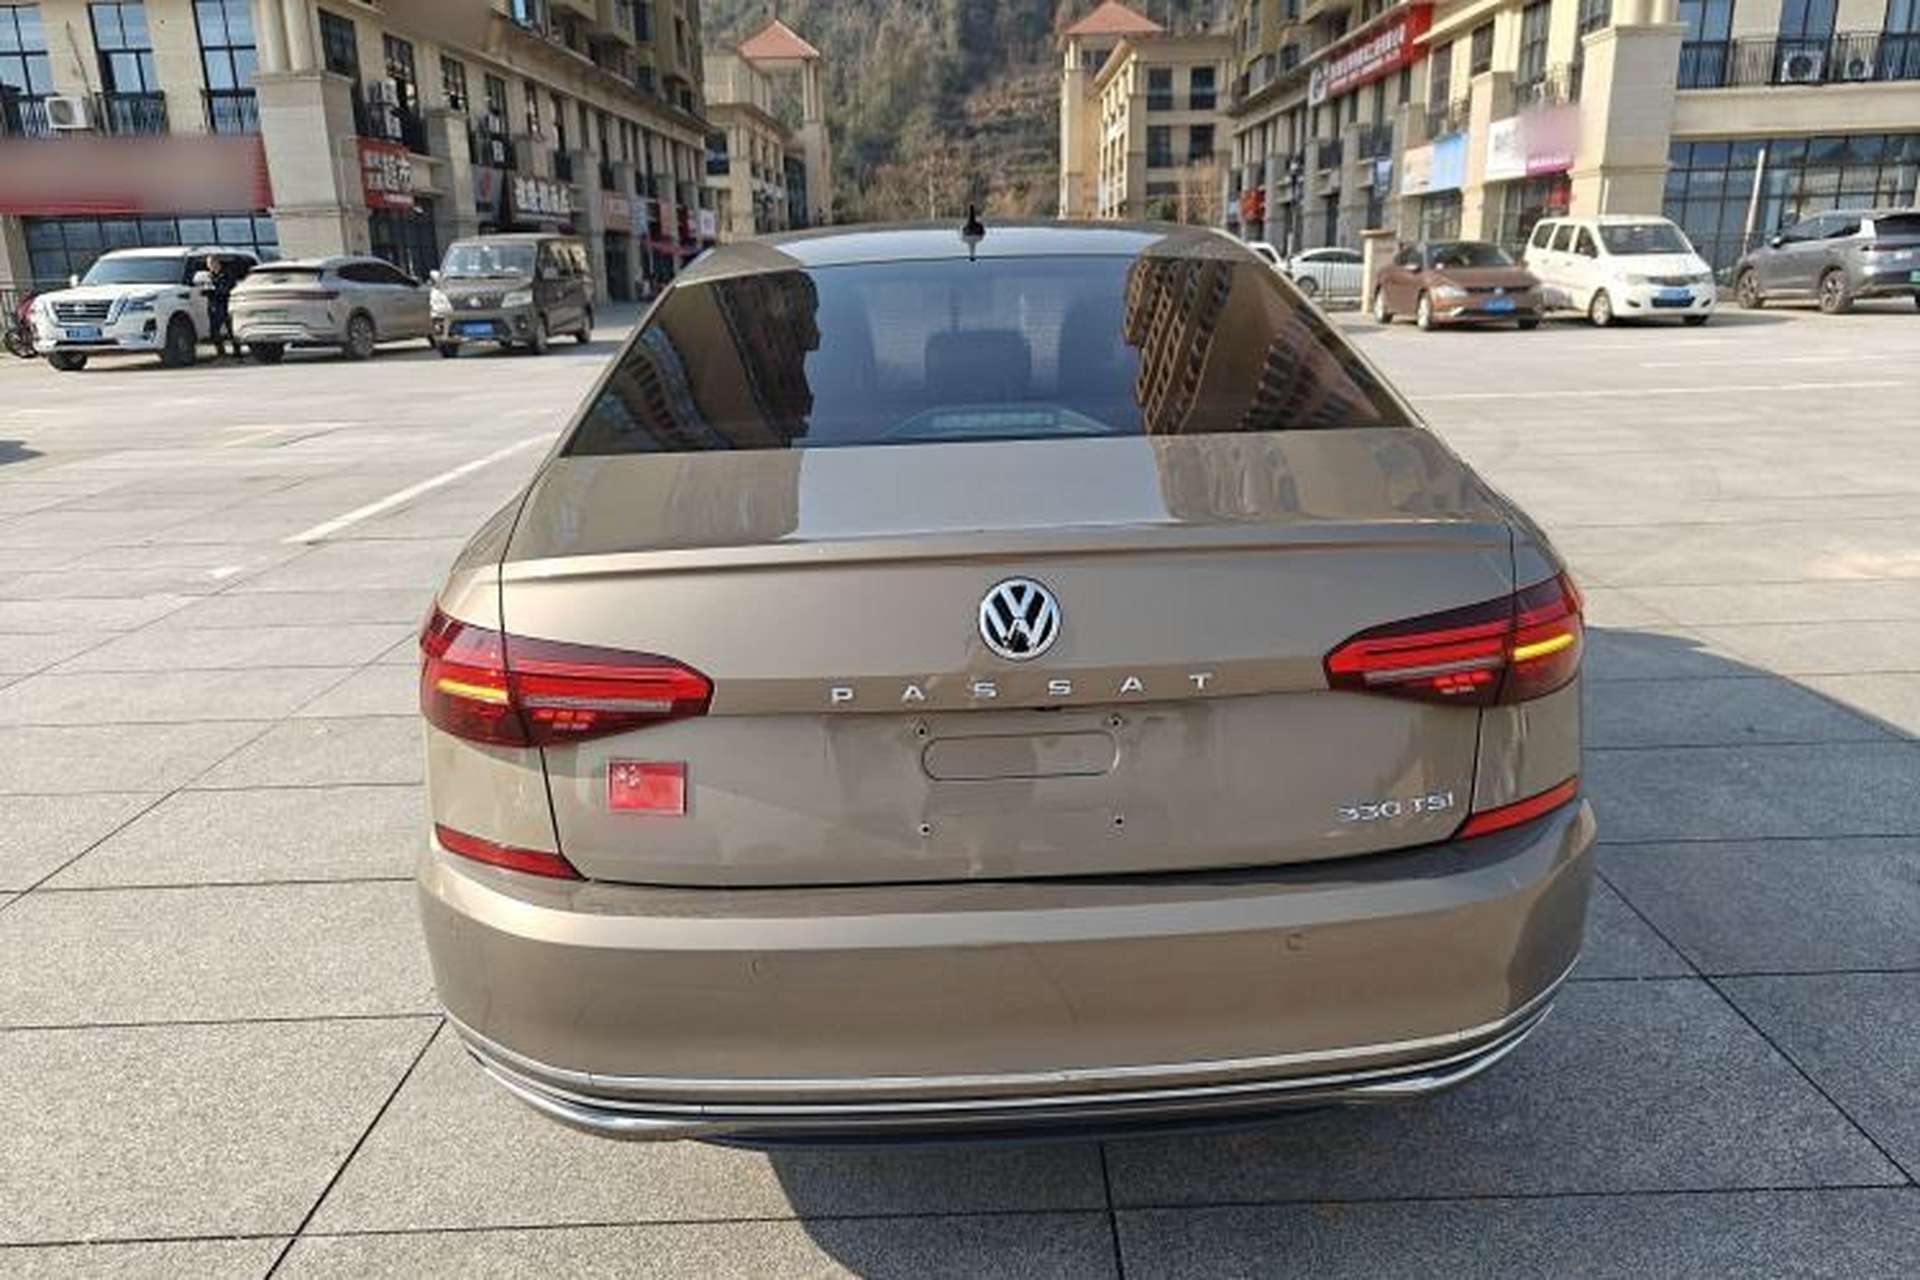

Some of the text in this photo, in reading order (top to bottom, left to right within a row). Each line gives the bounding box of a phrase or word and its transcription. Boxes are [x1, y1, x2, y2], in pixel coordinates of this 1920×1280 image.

[831, 671, 1212, 704] PASSAT
[1338, 792, 1454, 821] 330 TSI
